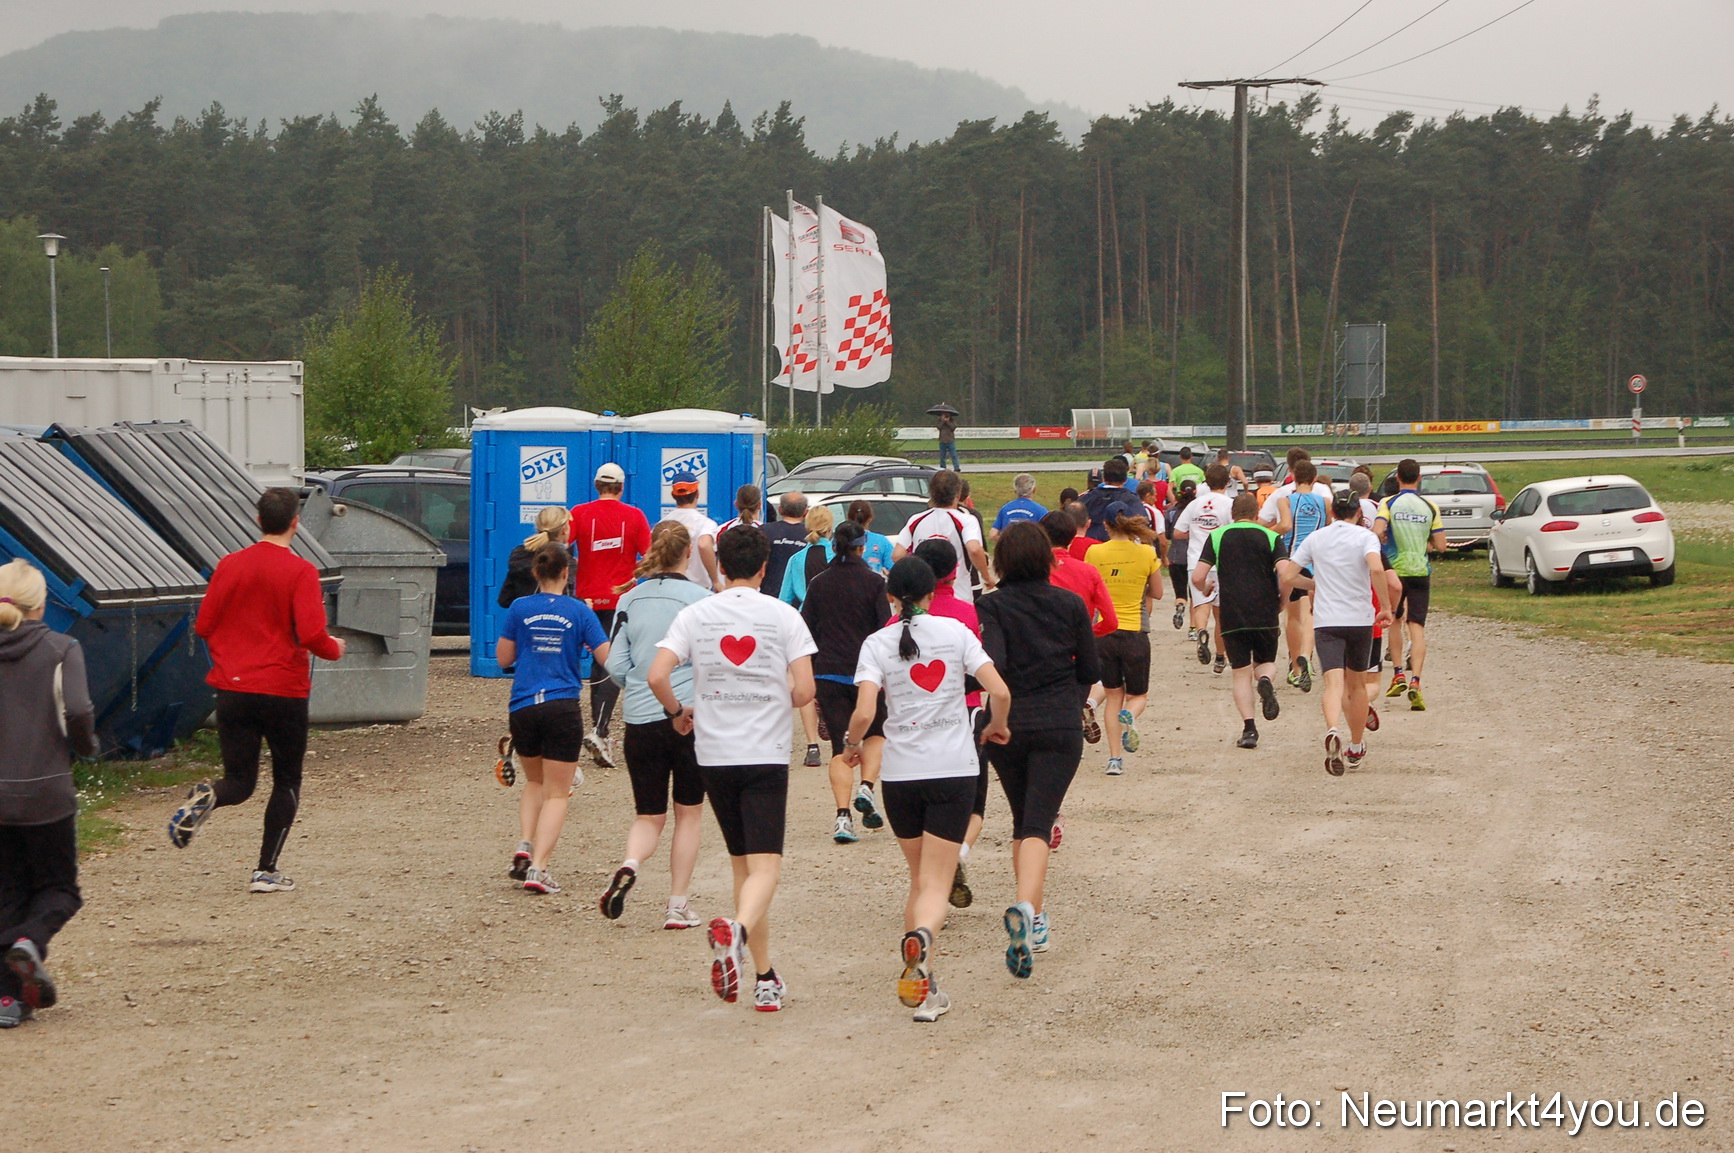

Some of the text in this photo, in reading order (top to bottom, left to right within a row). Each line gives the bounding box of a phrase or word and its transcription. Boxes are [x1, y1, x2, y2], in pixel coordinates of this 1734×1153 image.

[833, 243, 873, 257] SEAT
[1427, 422, 1484, 432] MAX BÖGL
